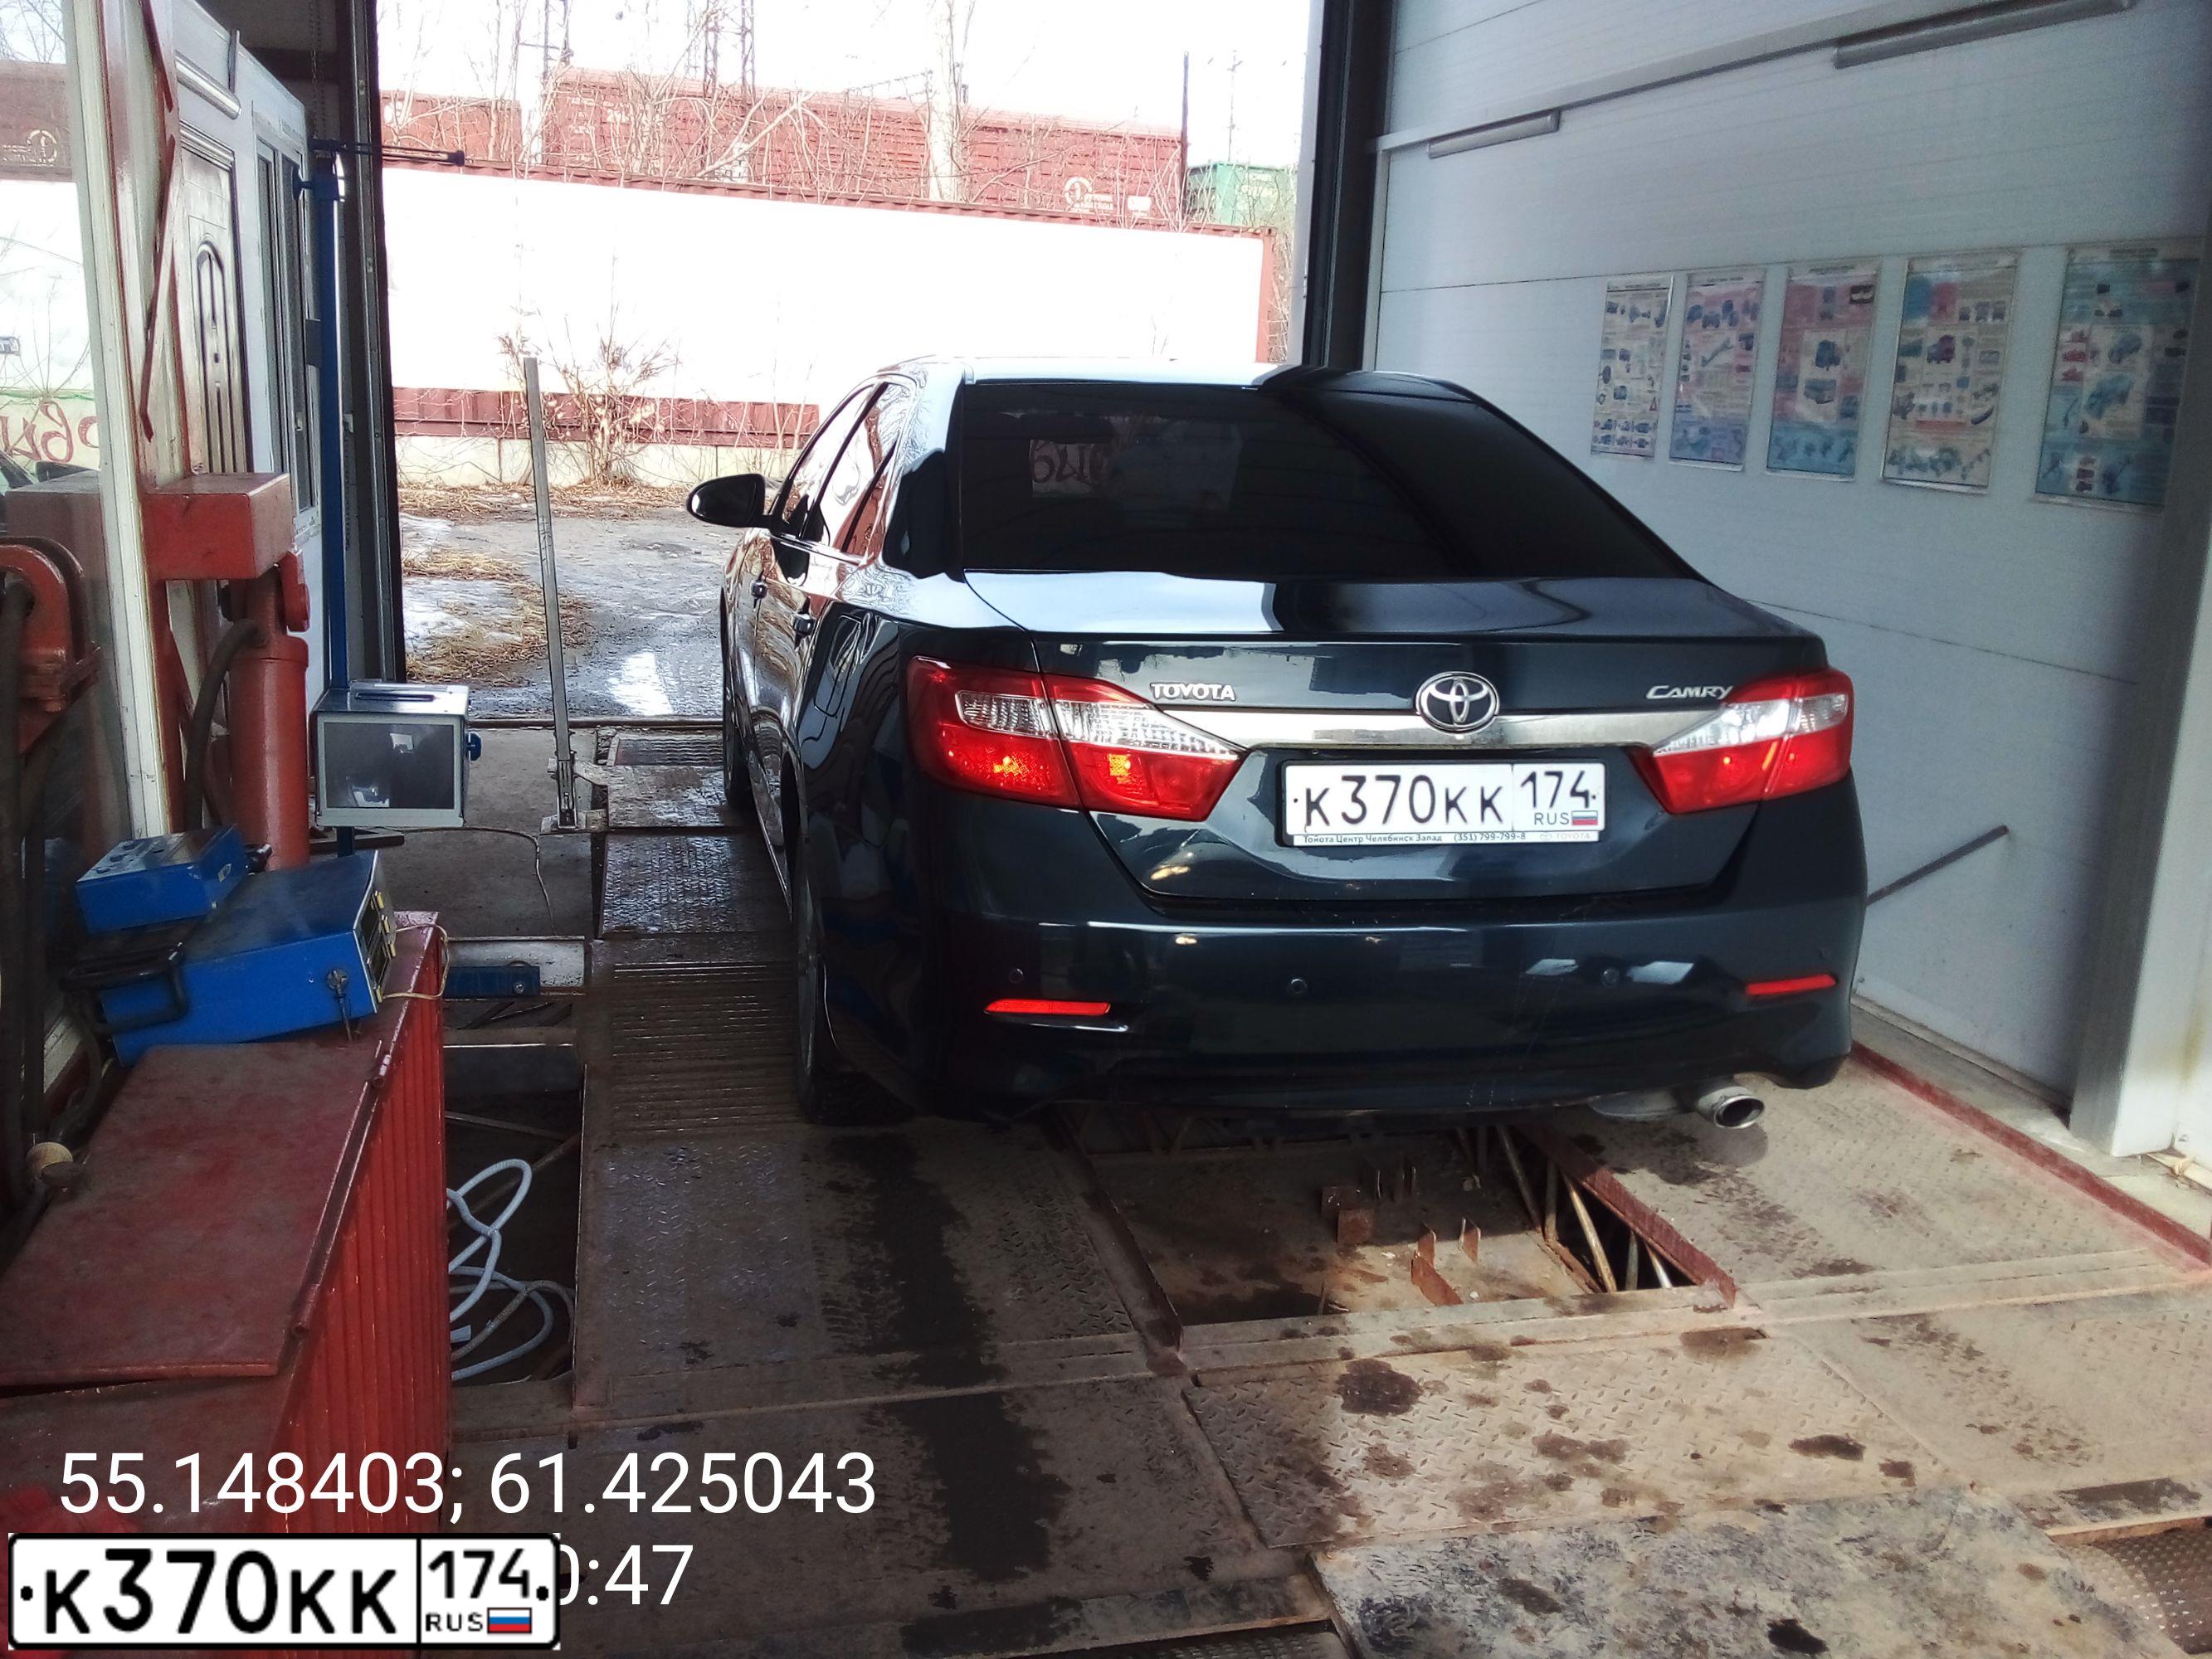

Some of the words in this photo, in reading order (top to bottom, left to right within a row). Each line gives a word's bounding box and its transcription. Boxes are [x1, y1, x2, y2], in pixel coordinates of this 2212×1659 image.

[1150, 683, 1236, 701] TOYOTA
[1520, 771, 1590, 809] 174
[1534, 812, 1570, 825] RUS
[1336, 834, 1363, 844] Центр
[1366, 834, 1414, 843] Челябинск
[1415, 834, 1443, 843] Запад
[1454, 832, 1478, 842] (351)
[1556, 832, 1591, 840] TOYOTA
